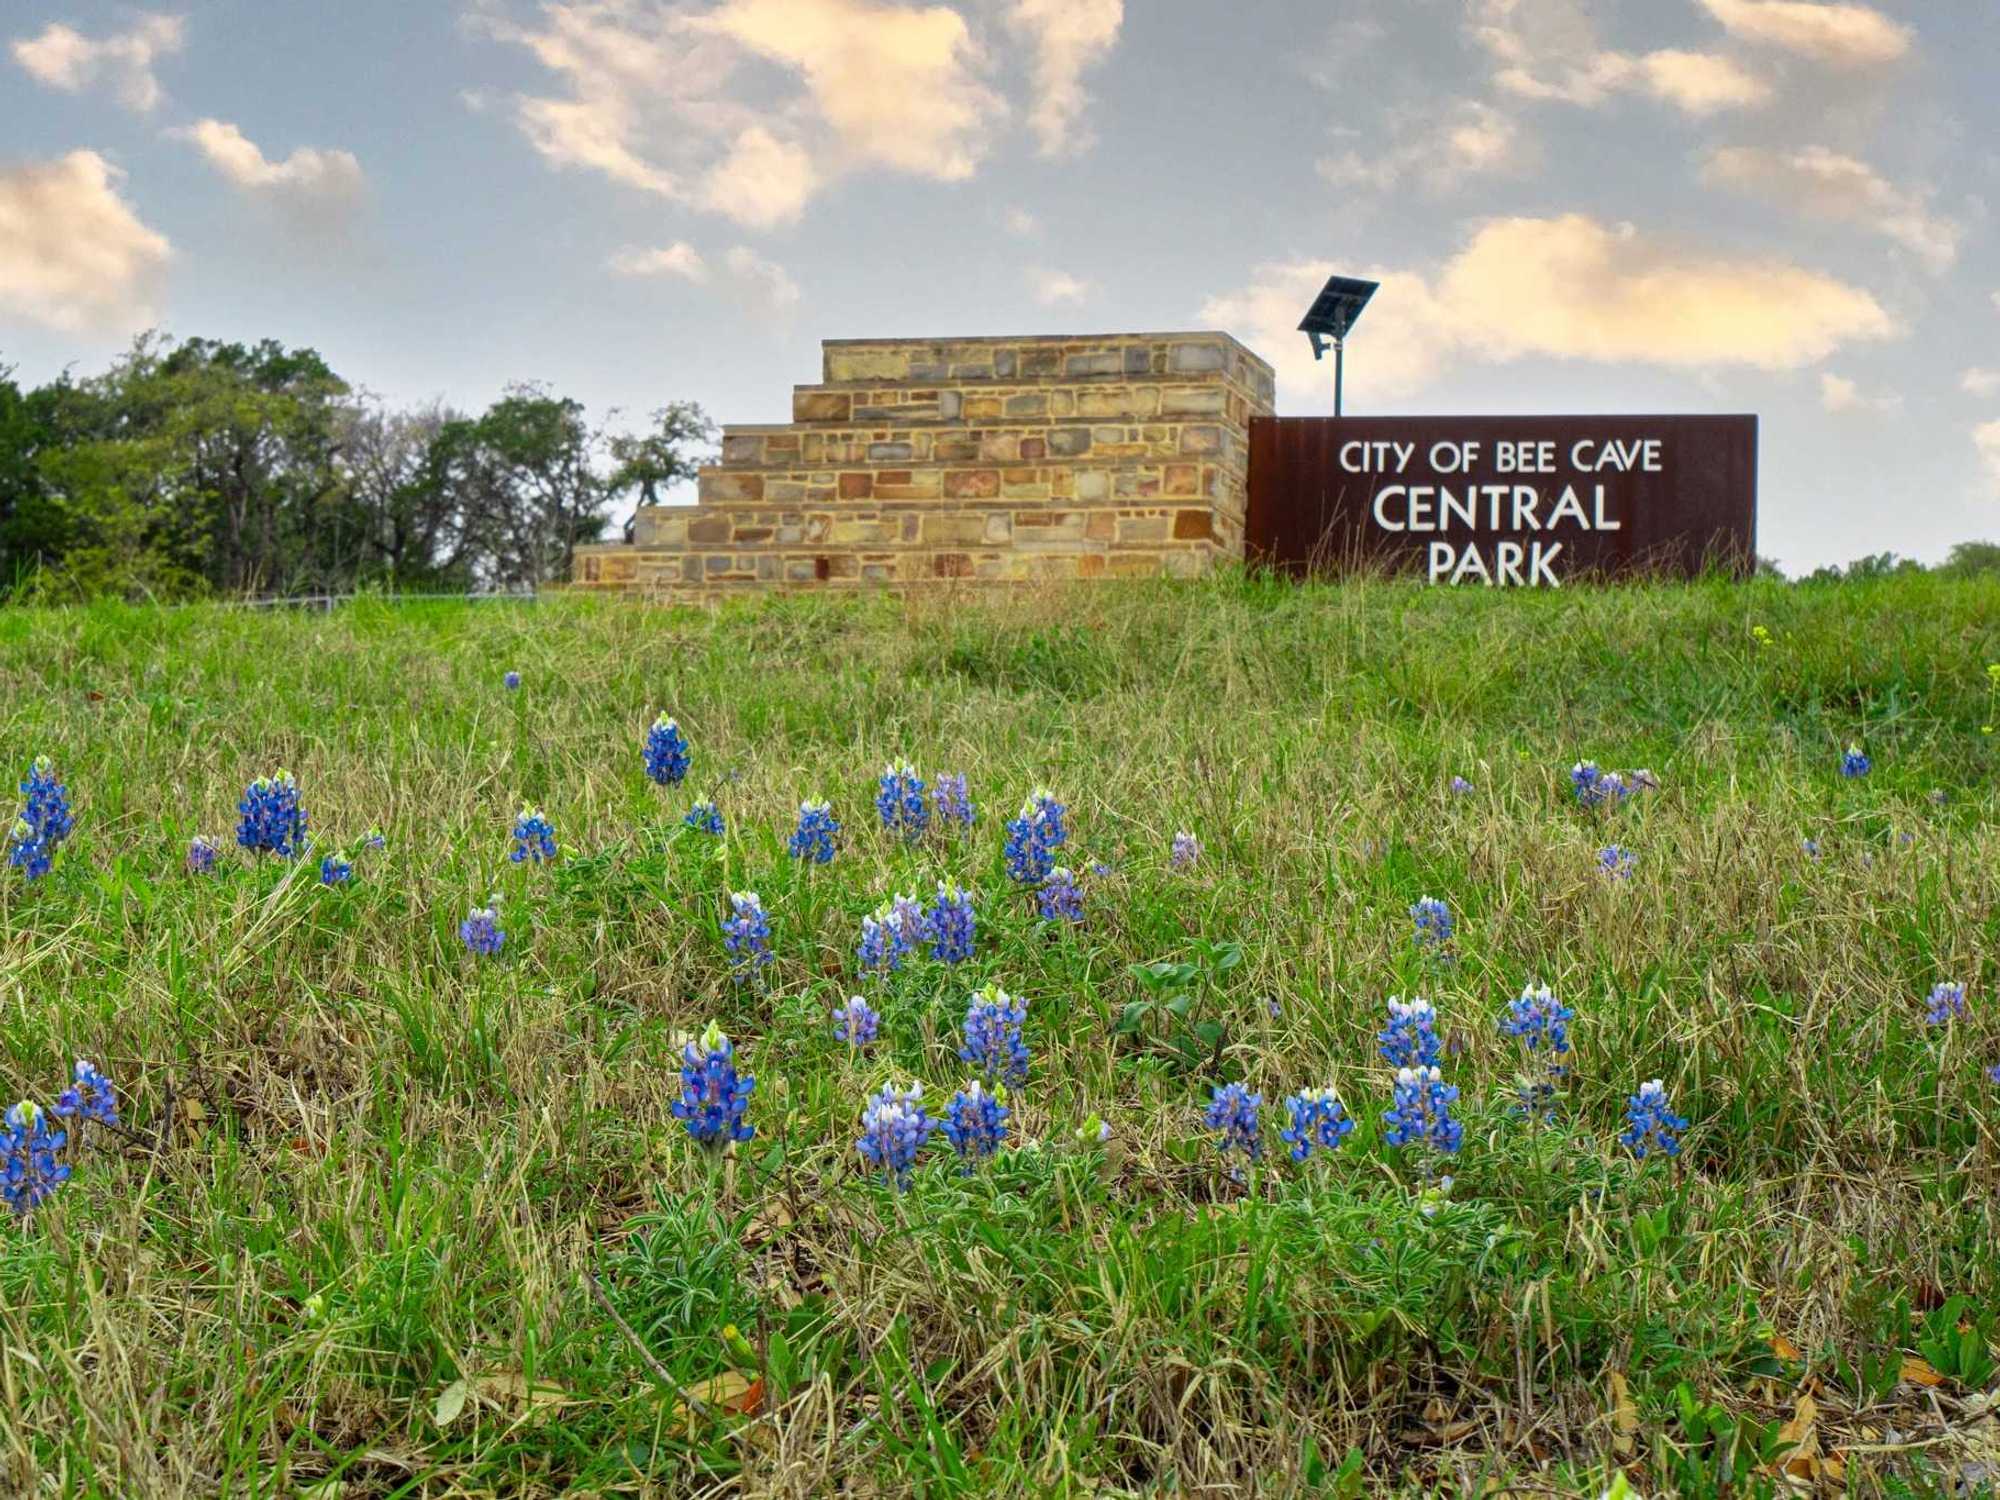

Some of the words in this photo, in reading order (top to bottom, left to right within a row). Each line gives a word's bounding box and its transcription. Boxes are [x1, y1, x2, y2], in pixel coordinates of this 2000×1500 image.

[1339, 440, 1415, 473] CITY
[1429, 441, 1481, 473] OF
[1496, 441, 1557, 473] BEE
[1571, 439, 1663, 472] CAVE
[1373, 484, 1621, 532] CENTRAL
[1428, 541, 1563, 588] PARK
